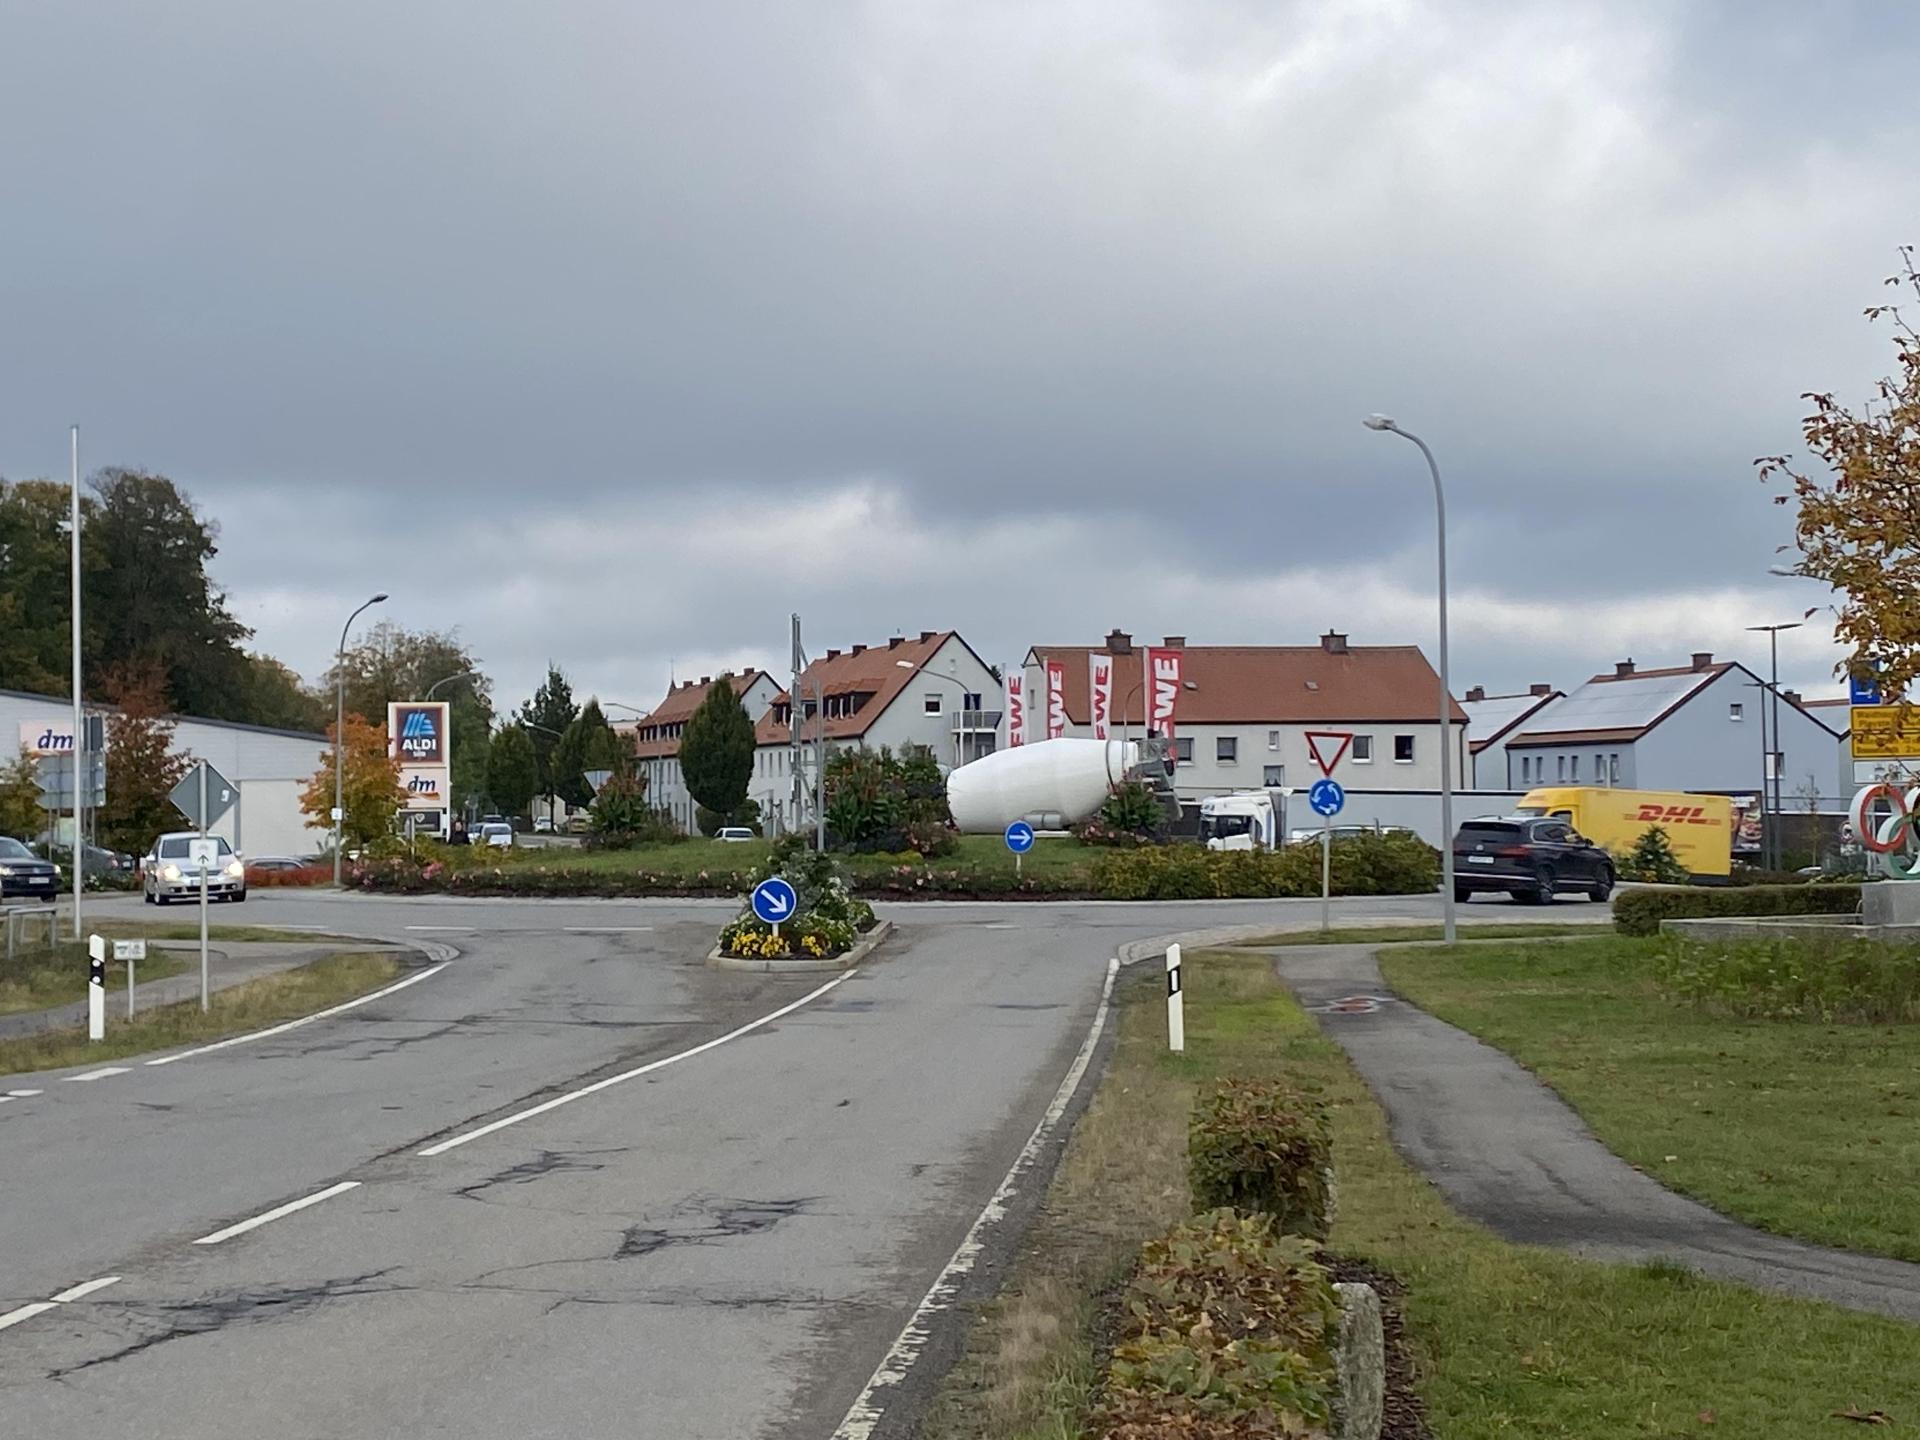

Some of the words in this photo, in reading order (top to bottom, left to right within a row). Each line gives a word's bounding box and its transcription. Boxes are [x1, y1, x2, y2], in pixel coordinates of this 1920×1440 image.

[1008, 676, 1024, 747] EWE
[1049, 670, 1064, 739] EWE
[1095, 665, 1108, 740] EWE
[1153, 658, 1179, 738] EWE
[37, 729, 74, 749] dm
[402, 738, 437, 750] ALDI
[407, 776, 436, 792] dm
[1637, 804, 1705, 825] DHL
